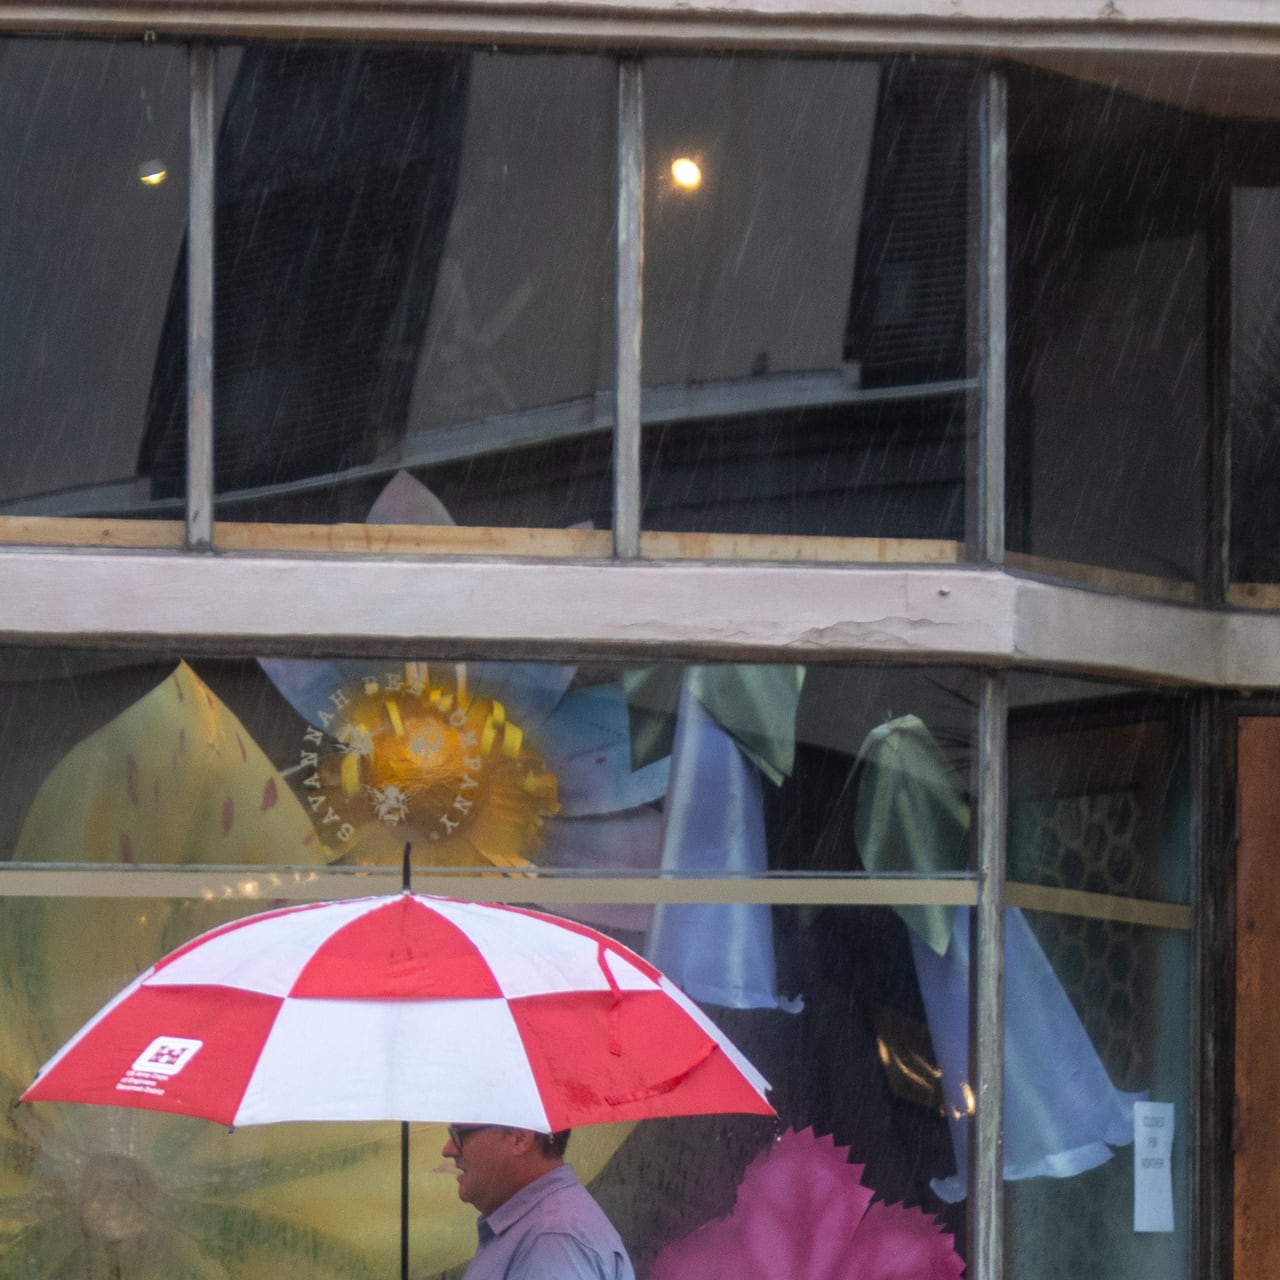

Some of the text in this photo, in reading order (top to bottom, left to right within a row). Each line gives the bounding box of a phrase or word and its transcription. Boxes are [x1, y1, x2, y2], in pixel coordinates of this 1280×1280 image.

[301, 673, 482, 842] SAVANNAH BEE COMPANY
